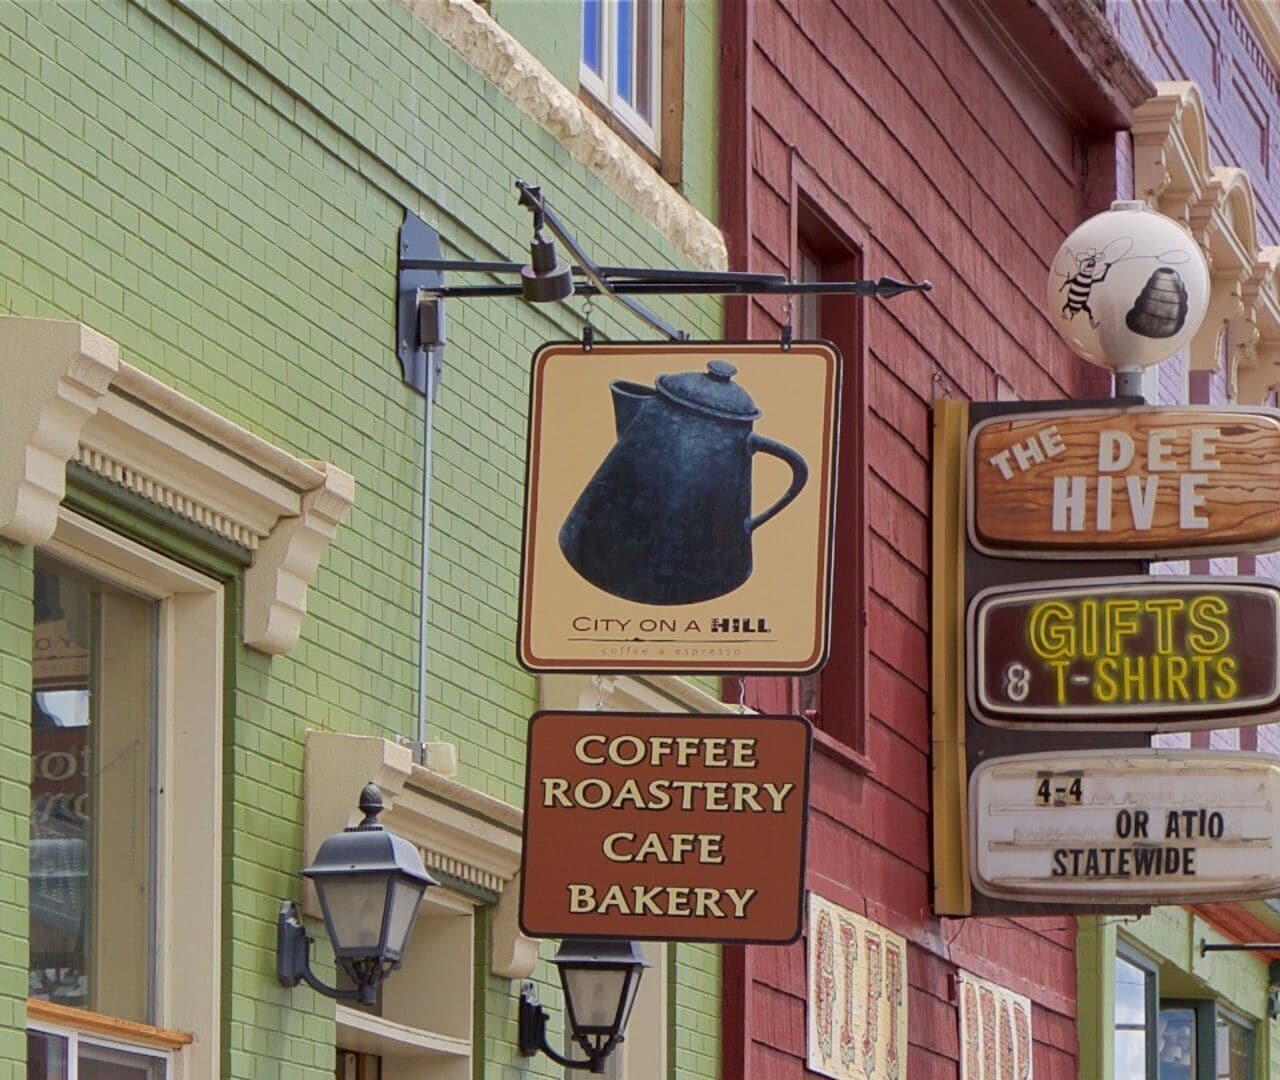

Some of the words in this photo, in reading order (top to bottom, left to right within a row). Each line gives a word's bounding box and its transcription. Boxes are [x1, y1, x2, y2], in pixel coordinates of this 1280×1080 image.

[990, 426, 1066, 481] THE
[1051, 473, 1210, 532] HIVE
[683, 618, 701, 632] A
[711, 617, 771, 633] HILL
[1029, 596, 1231, 659] GIFTS
[1048, 655, 1238, 703] T-SHIRTS
[575, 735, 757, 768] COFFEE
[541, 778, 794, 812] ROASTERY
[1115, 809, 1149, 838] OR
[602, 832, 725, 864] CAFE
[1052, 848, 1197, 877] STATEWIDE
[568, 884, 756, 918] BAKERY
